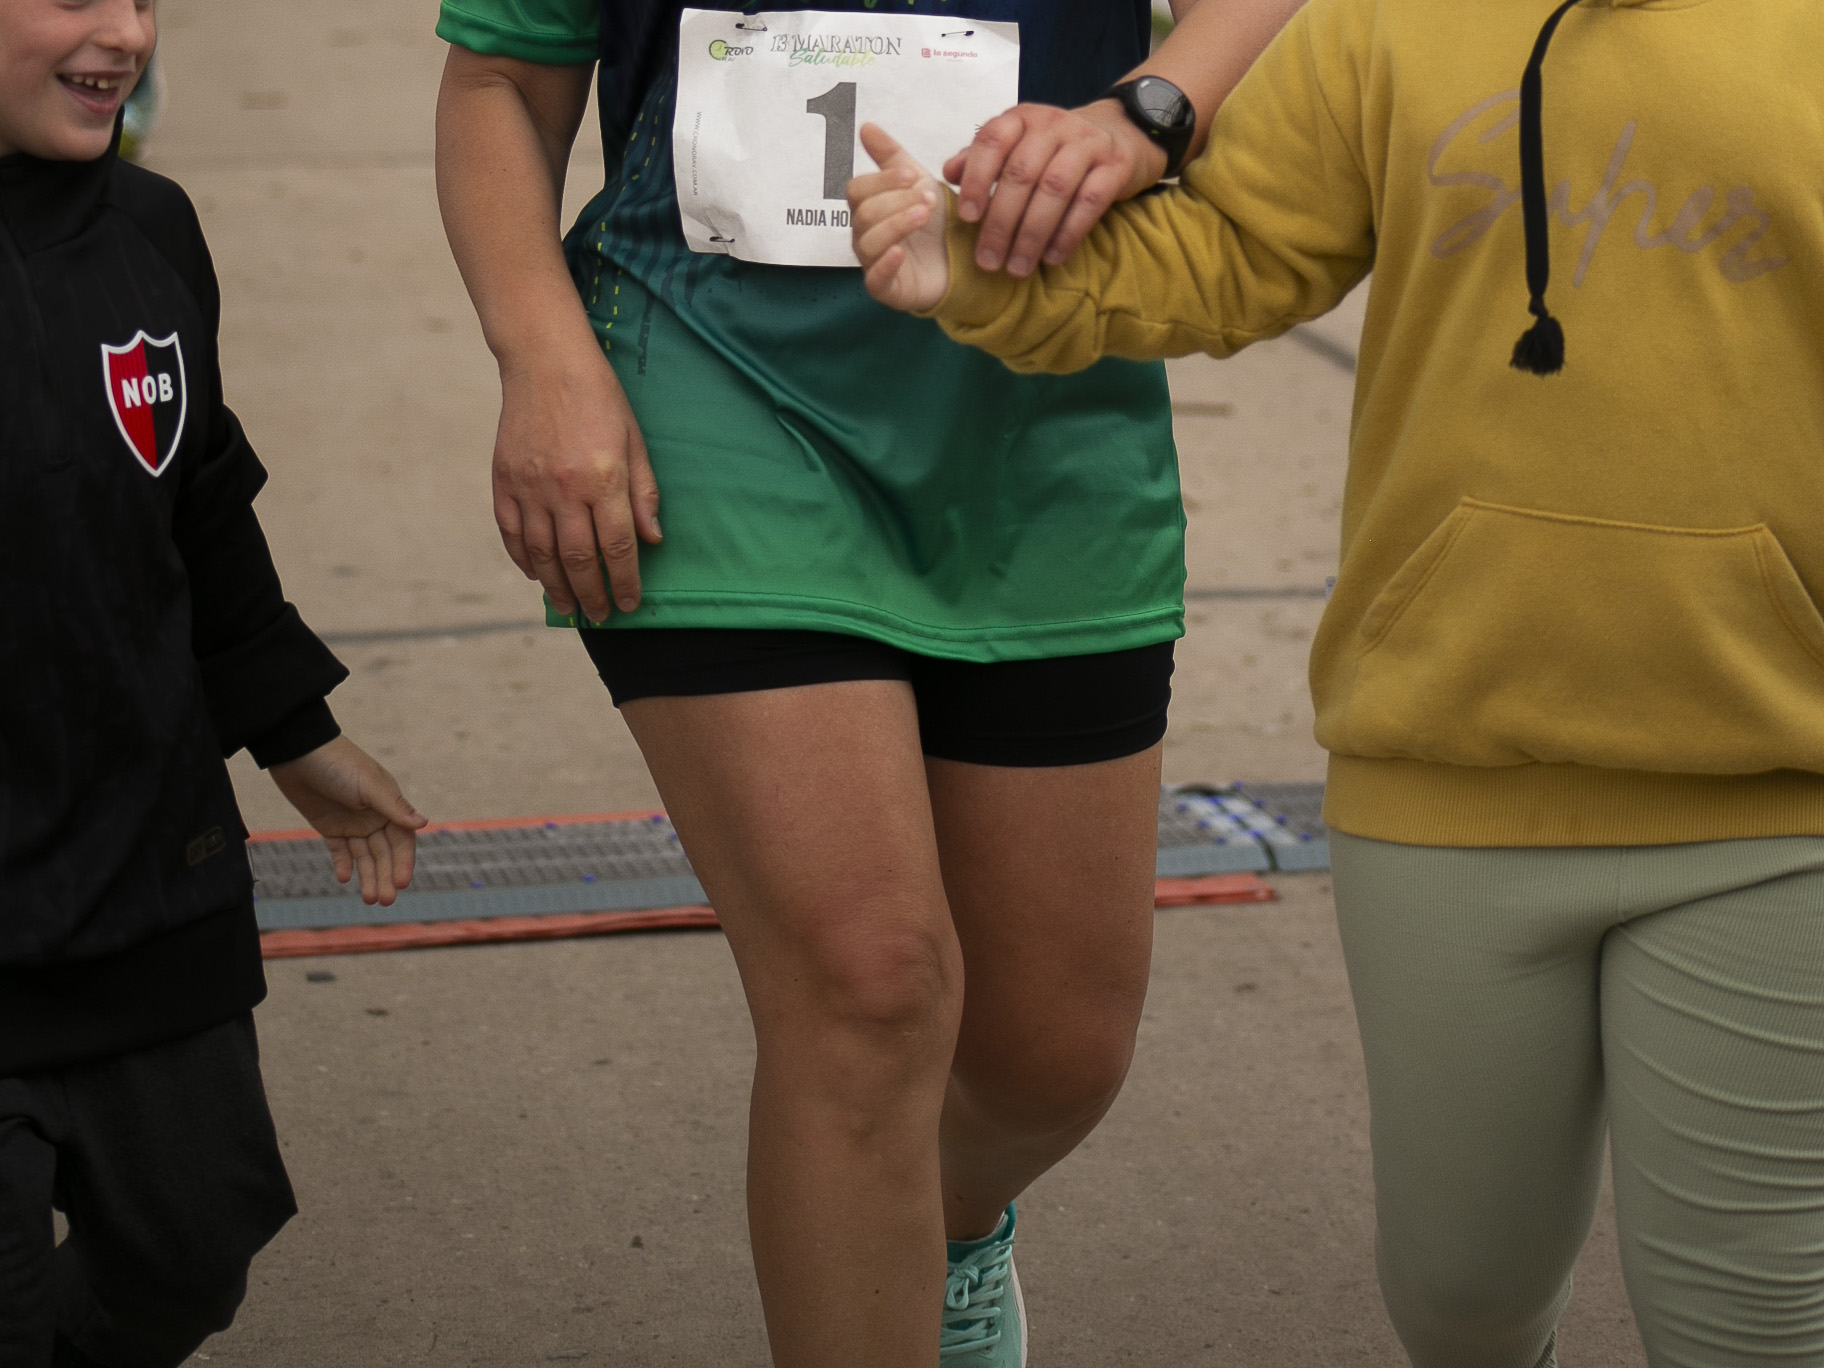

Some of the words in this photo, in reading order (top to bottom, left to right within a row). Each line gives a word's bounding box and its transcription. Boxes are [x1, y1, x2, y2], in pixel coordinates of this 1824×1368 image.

[788, 46, 876, 69] Saludable
[806, 81, 857, 201] 1
[786, 208, 828, 227] NADIA
[120, 372, 174, 409] NOB
